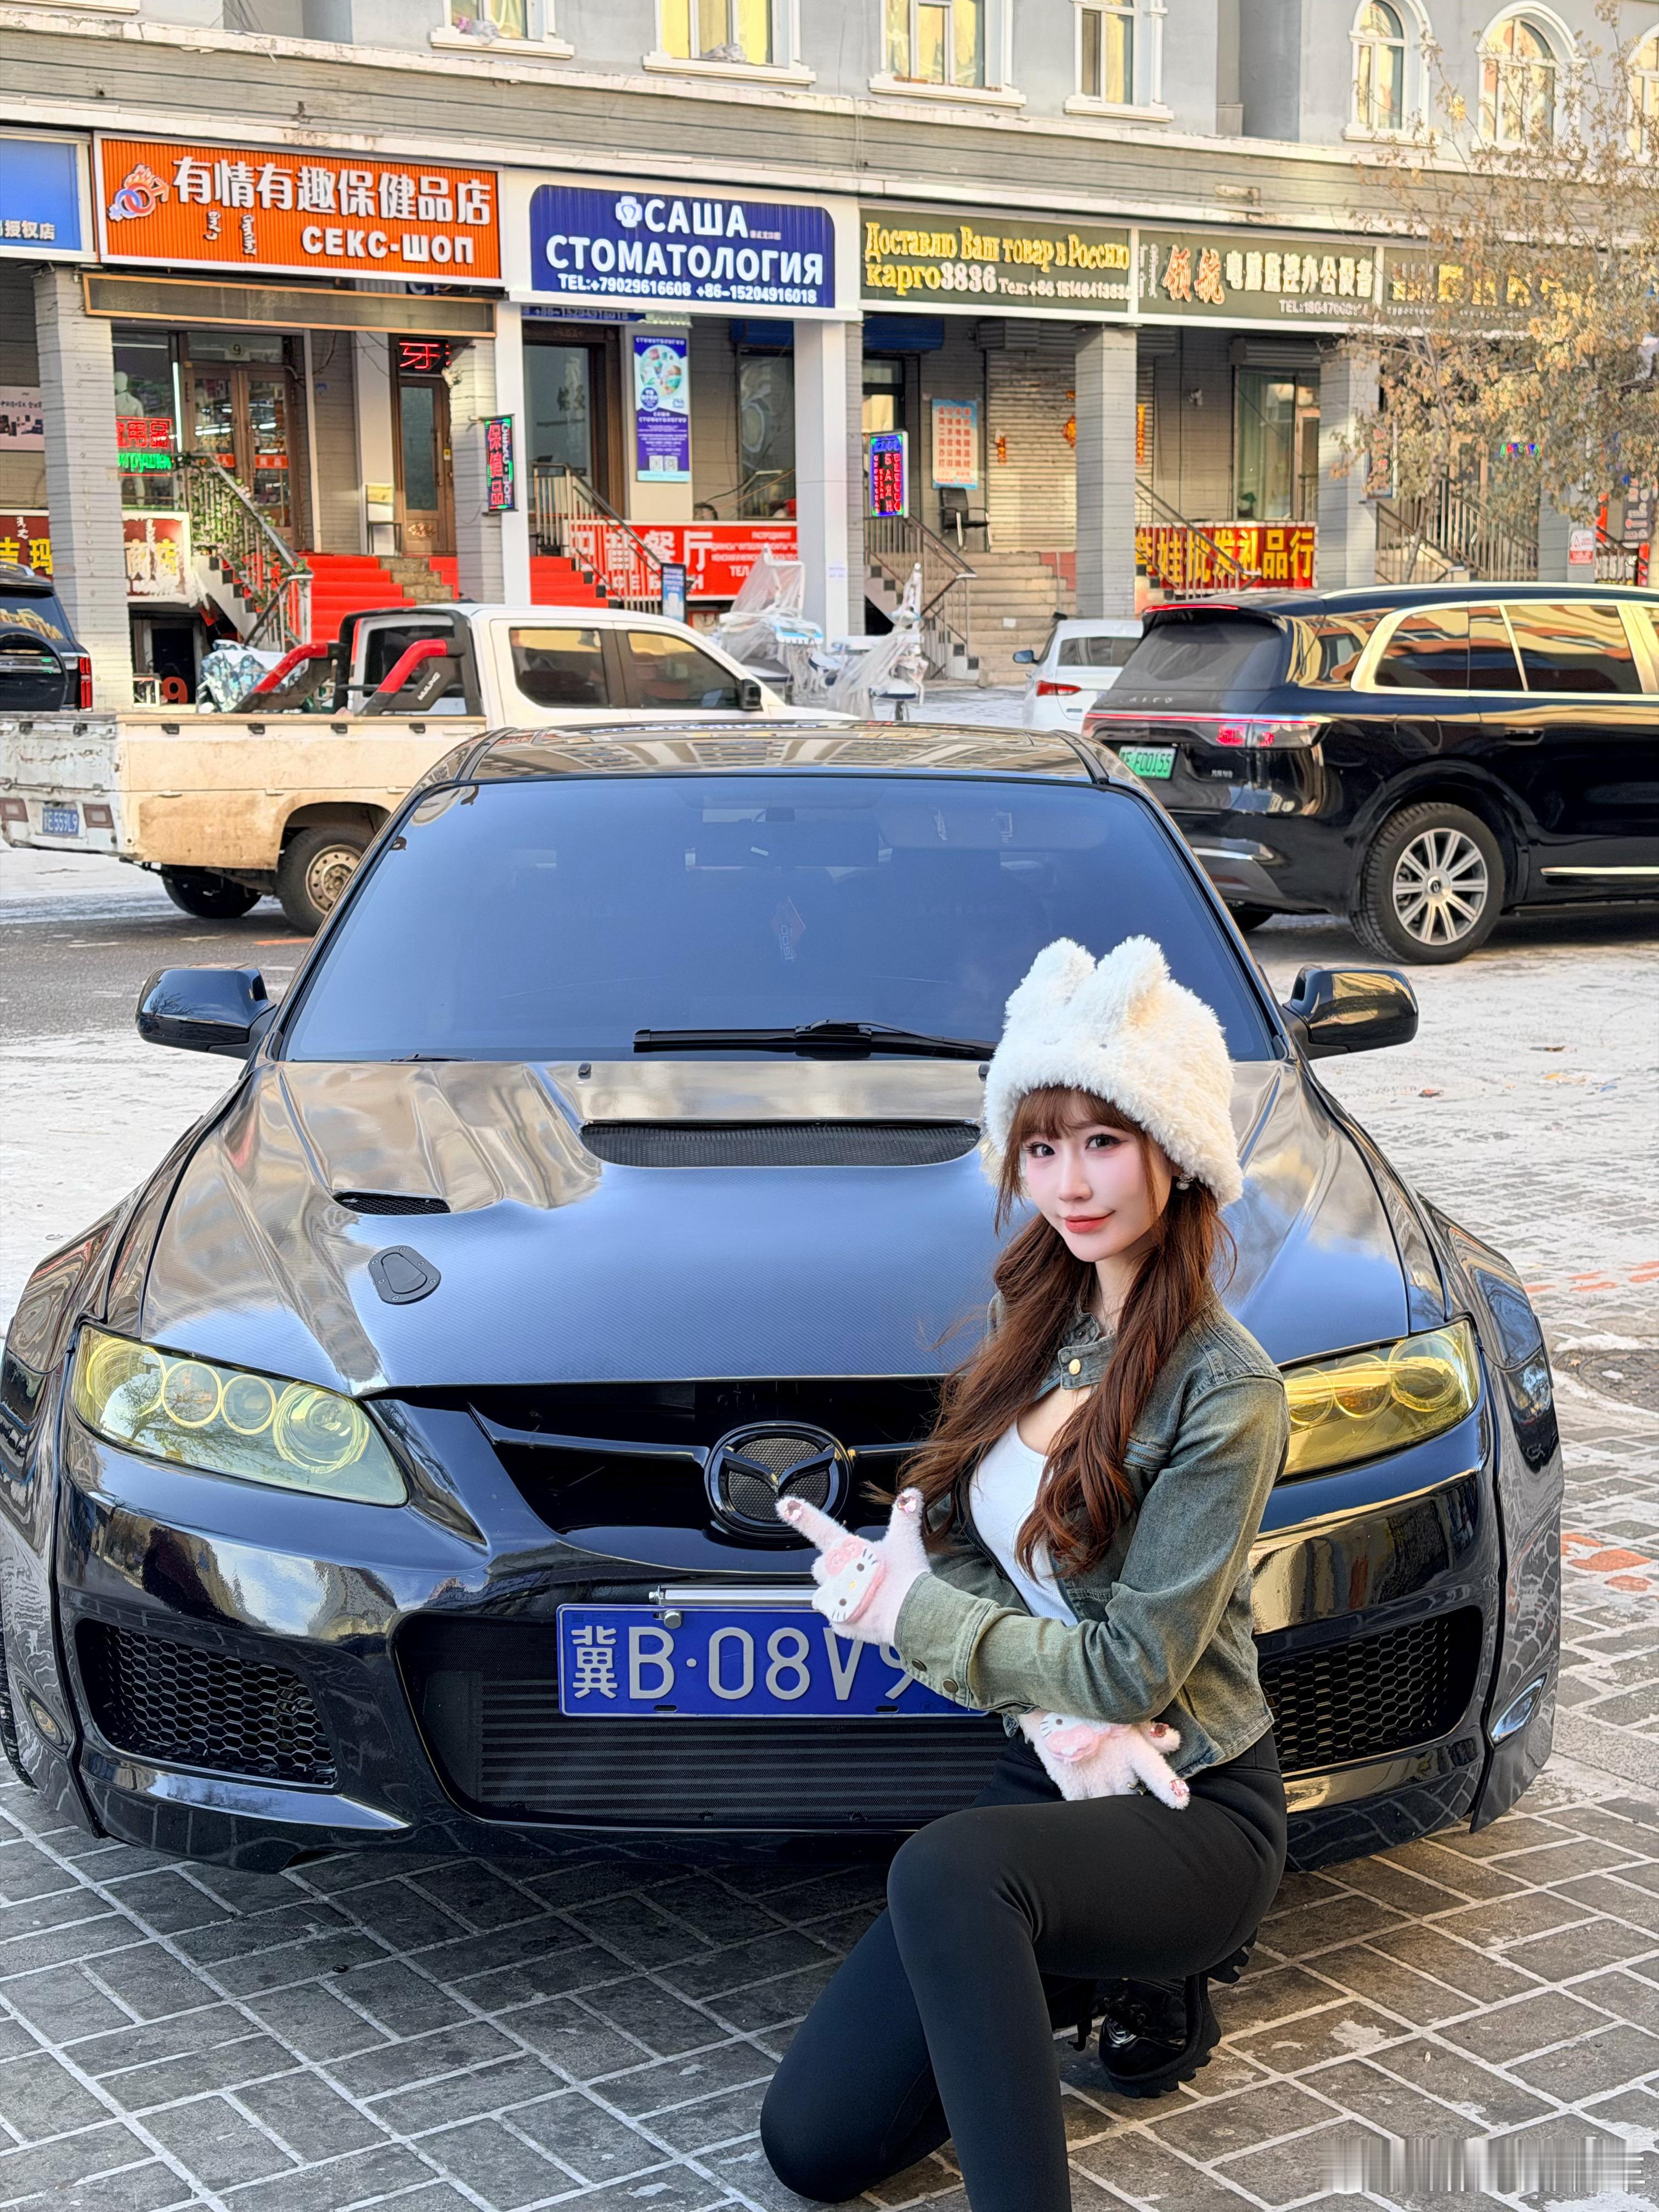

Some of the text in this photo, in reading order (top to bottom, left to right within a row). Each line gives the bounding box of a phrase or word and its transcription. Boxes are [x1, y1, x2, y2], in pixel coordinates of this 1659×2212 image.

[172, 156, 491, 225] 有情有趣保健品店
[0, 219, 55, 240] 授权店
[645, 199, 748, 238] САША
[302, 226, 474, 264] СЕКС-ШОП
[546, 235, 823, 285] СТОМАТОЛОГИЯ
[865, 222, 1130, 272] Доставлю Ваш товар в Россию
[557, 273, 816, 303] TEL:+79029616608 +86-15204916018
[399, 342, 441, 369] 牙
